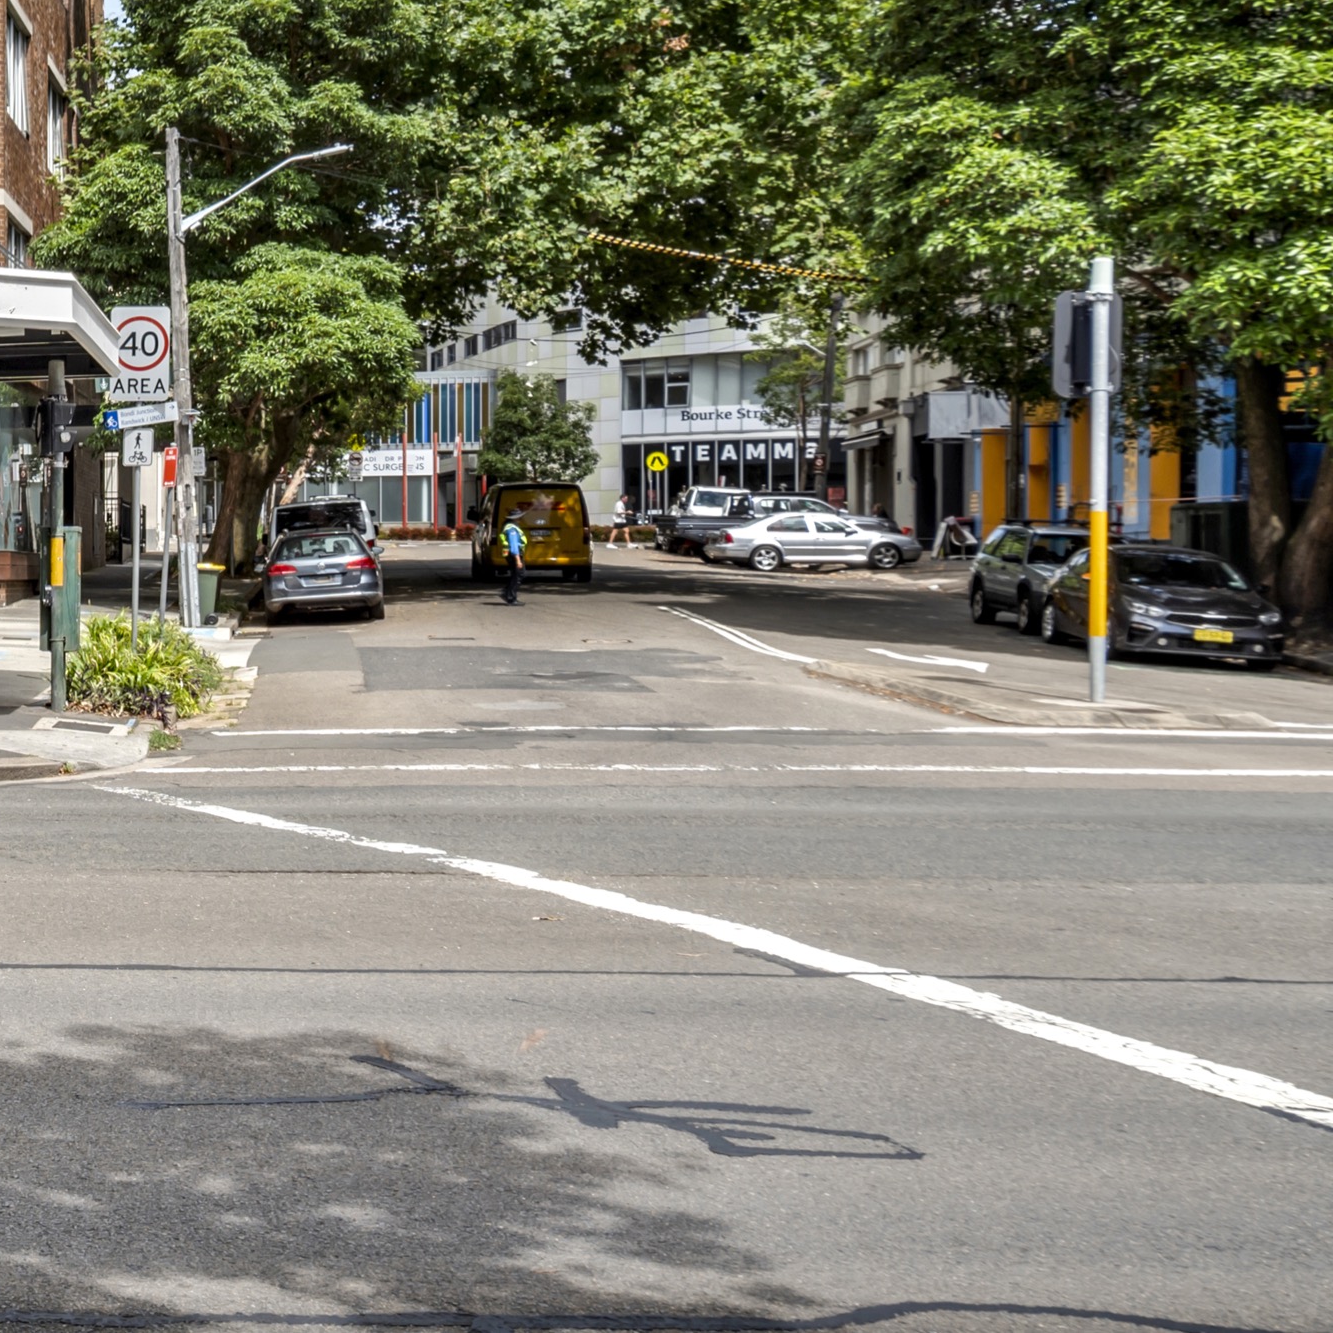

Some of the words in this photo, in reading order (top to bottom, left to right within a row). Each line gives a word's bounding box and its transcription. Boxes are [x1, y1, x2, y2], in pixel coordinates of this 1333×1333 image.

[119, 331, 159, 357] 40
[113, 378, 166, 394] AREA
[681, 409, 732, 421] Bourke
